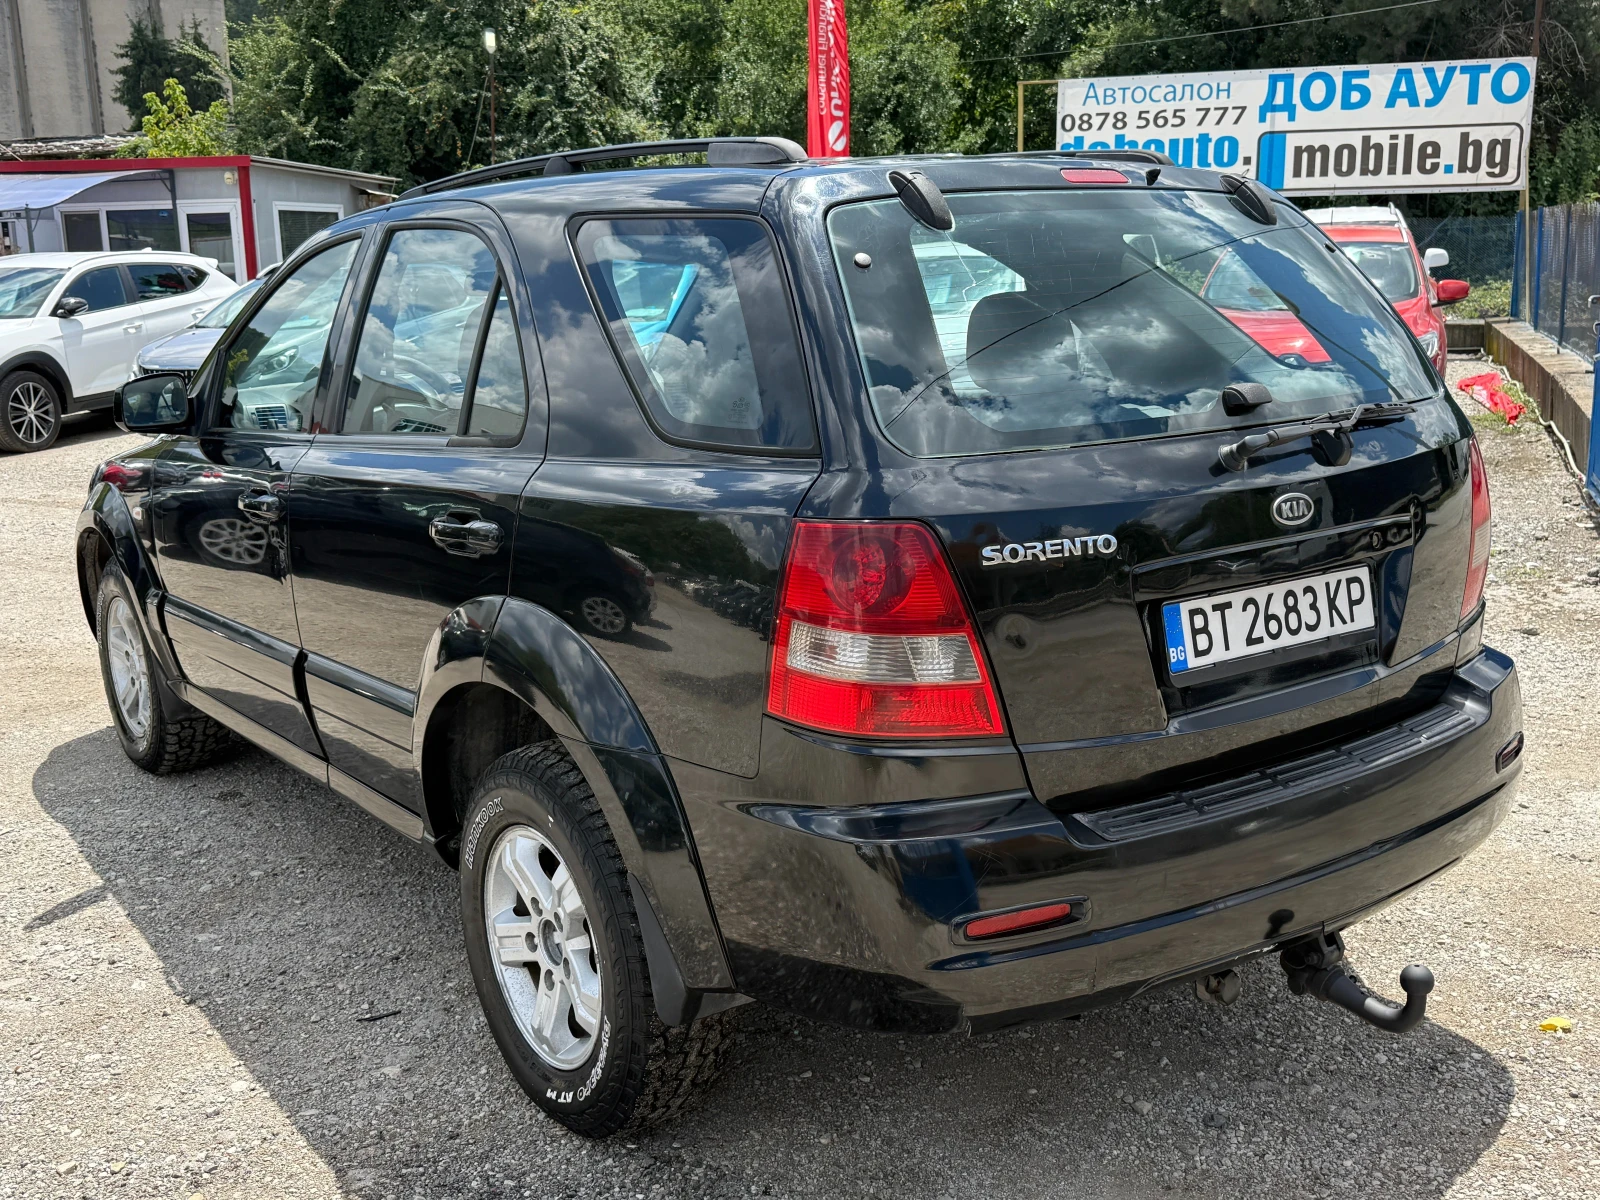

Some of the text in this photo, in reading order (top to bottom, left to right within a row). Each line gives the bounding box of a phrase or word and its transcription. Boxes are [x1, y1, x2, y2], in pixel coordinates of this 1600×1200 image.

[1082, 81, 1232, 106] Автосалон
[1258, 62, 1531, 124] ДОБ АУТО
[1060, 105, 1248, 133] 0878 565 777
[1292, 131, 1512, 178] mobile.bg
[980, 533, 1118, 567] SORENTO
[1169, 646, 1186, 663] BG
